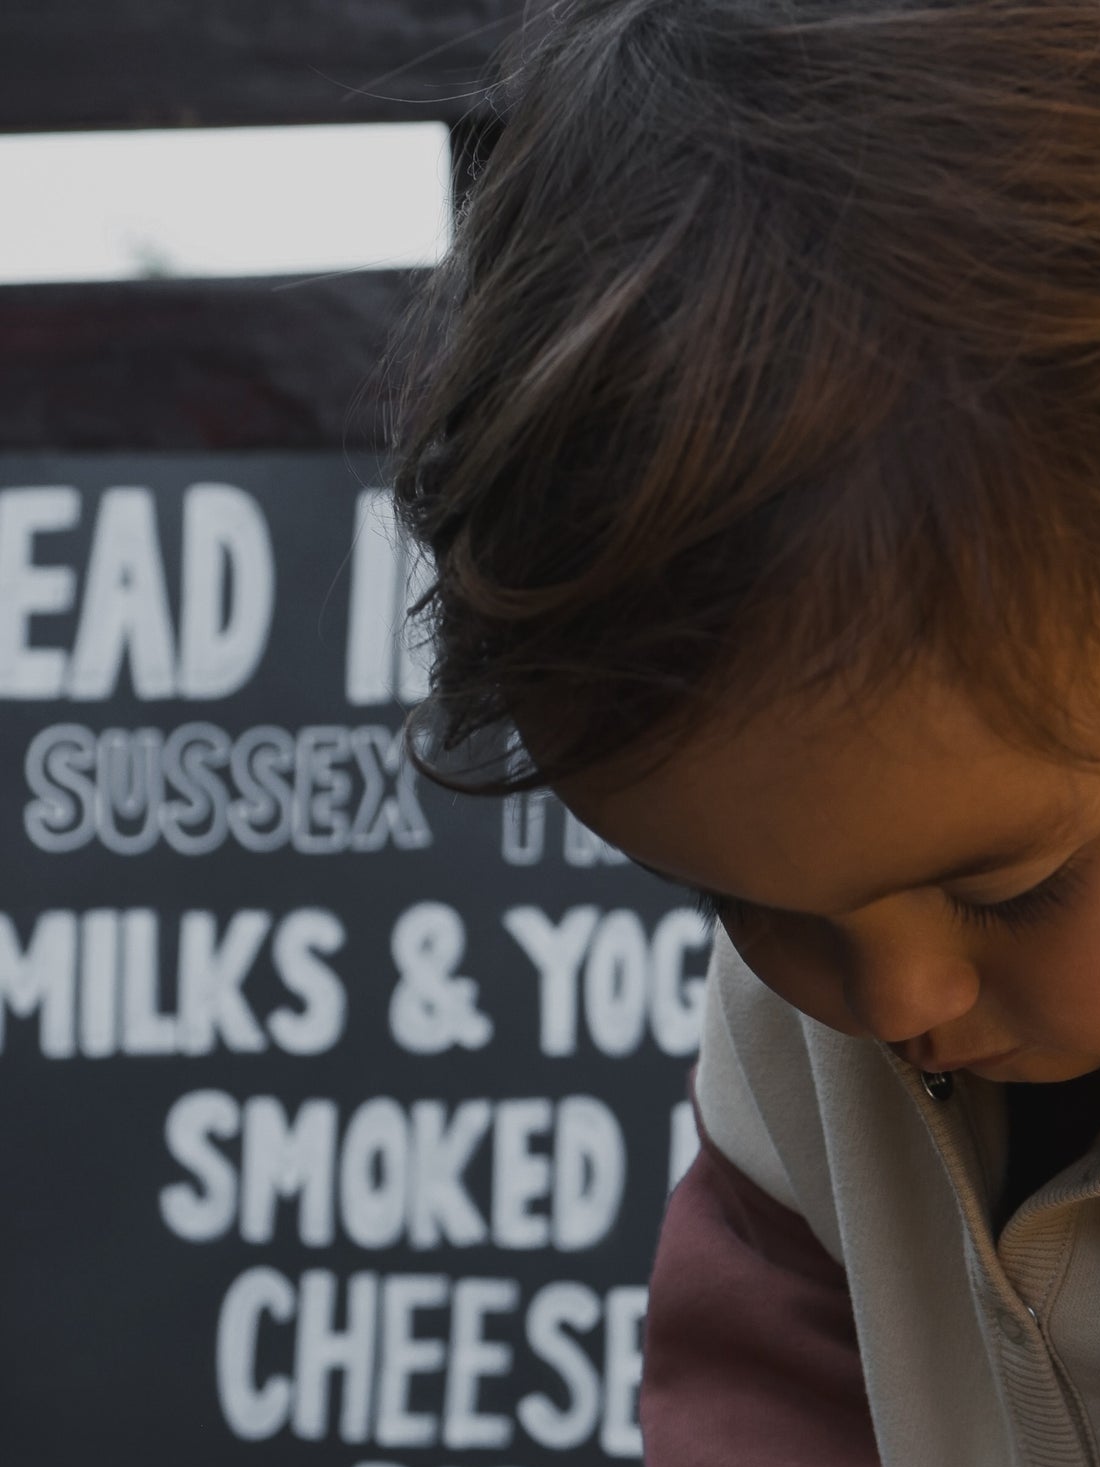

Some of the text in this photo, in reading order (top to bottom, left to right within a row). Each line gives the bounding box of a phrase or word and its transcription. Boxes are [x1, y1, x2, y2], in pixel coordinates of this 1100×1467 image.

[24, 722, 433, 855] SUSSEX
[0, 907, 346, 1058] MILKS
[389, 901, 494, 1055] &
[159, 1089, 628, 1253] SMOKED
